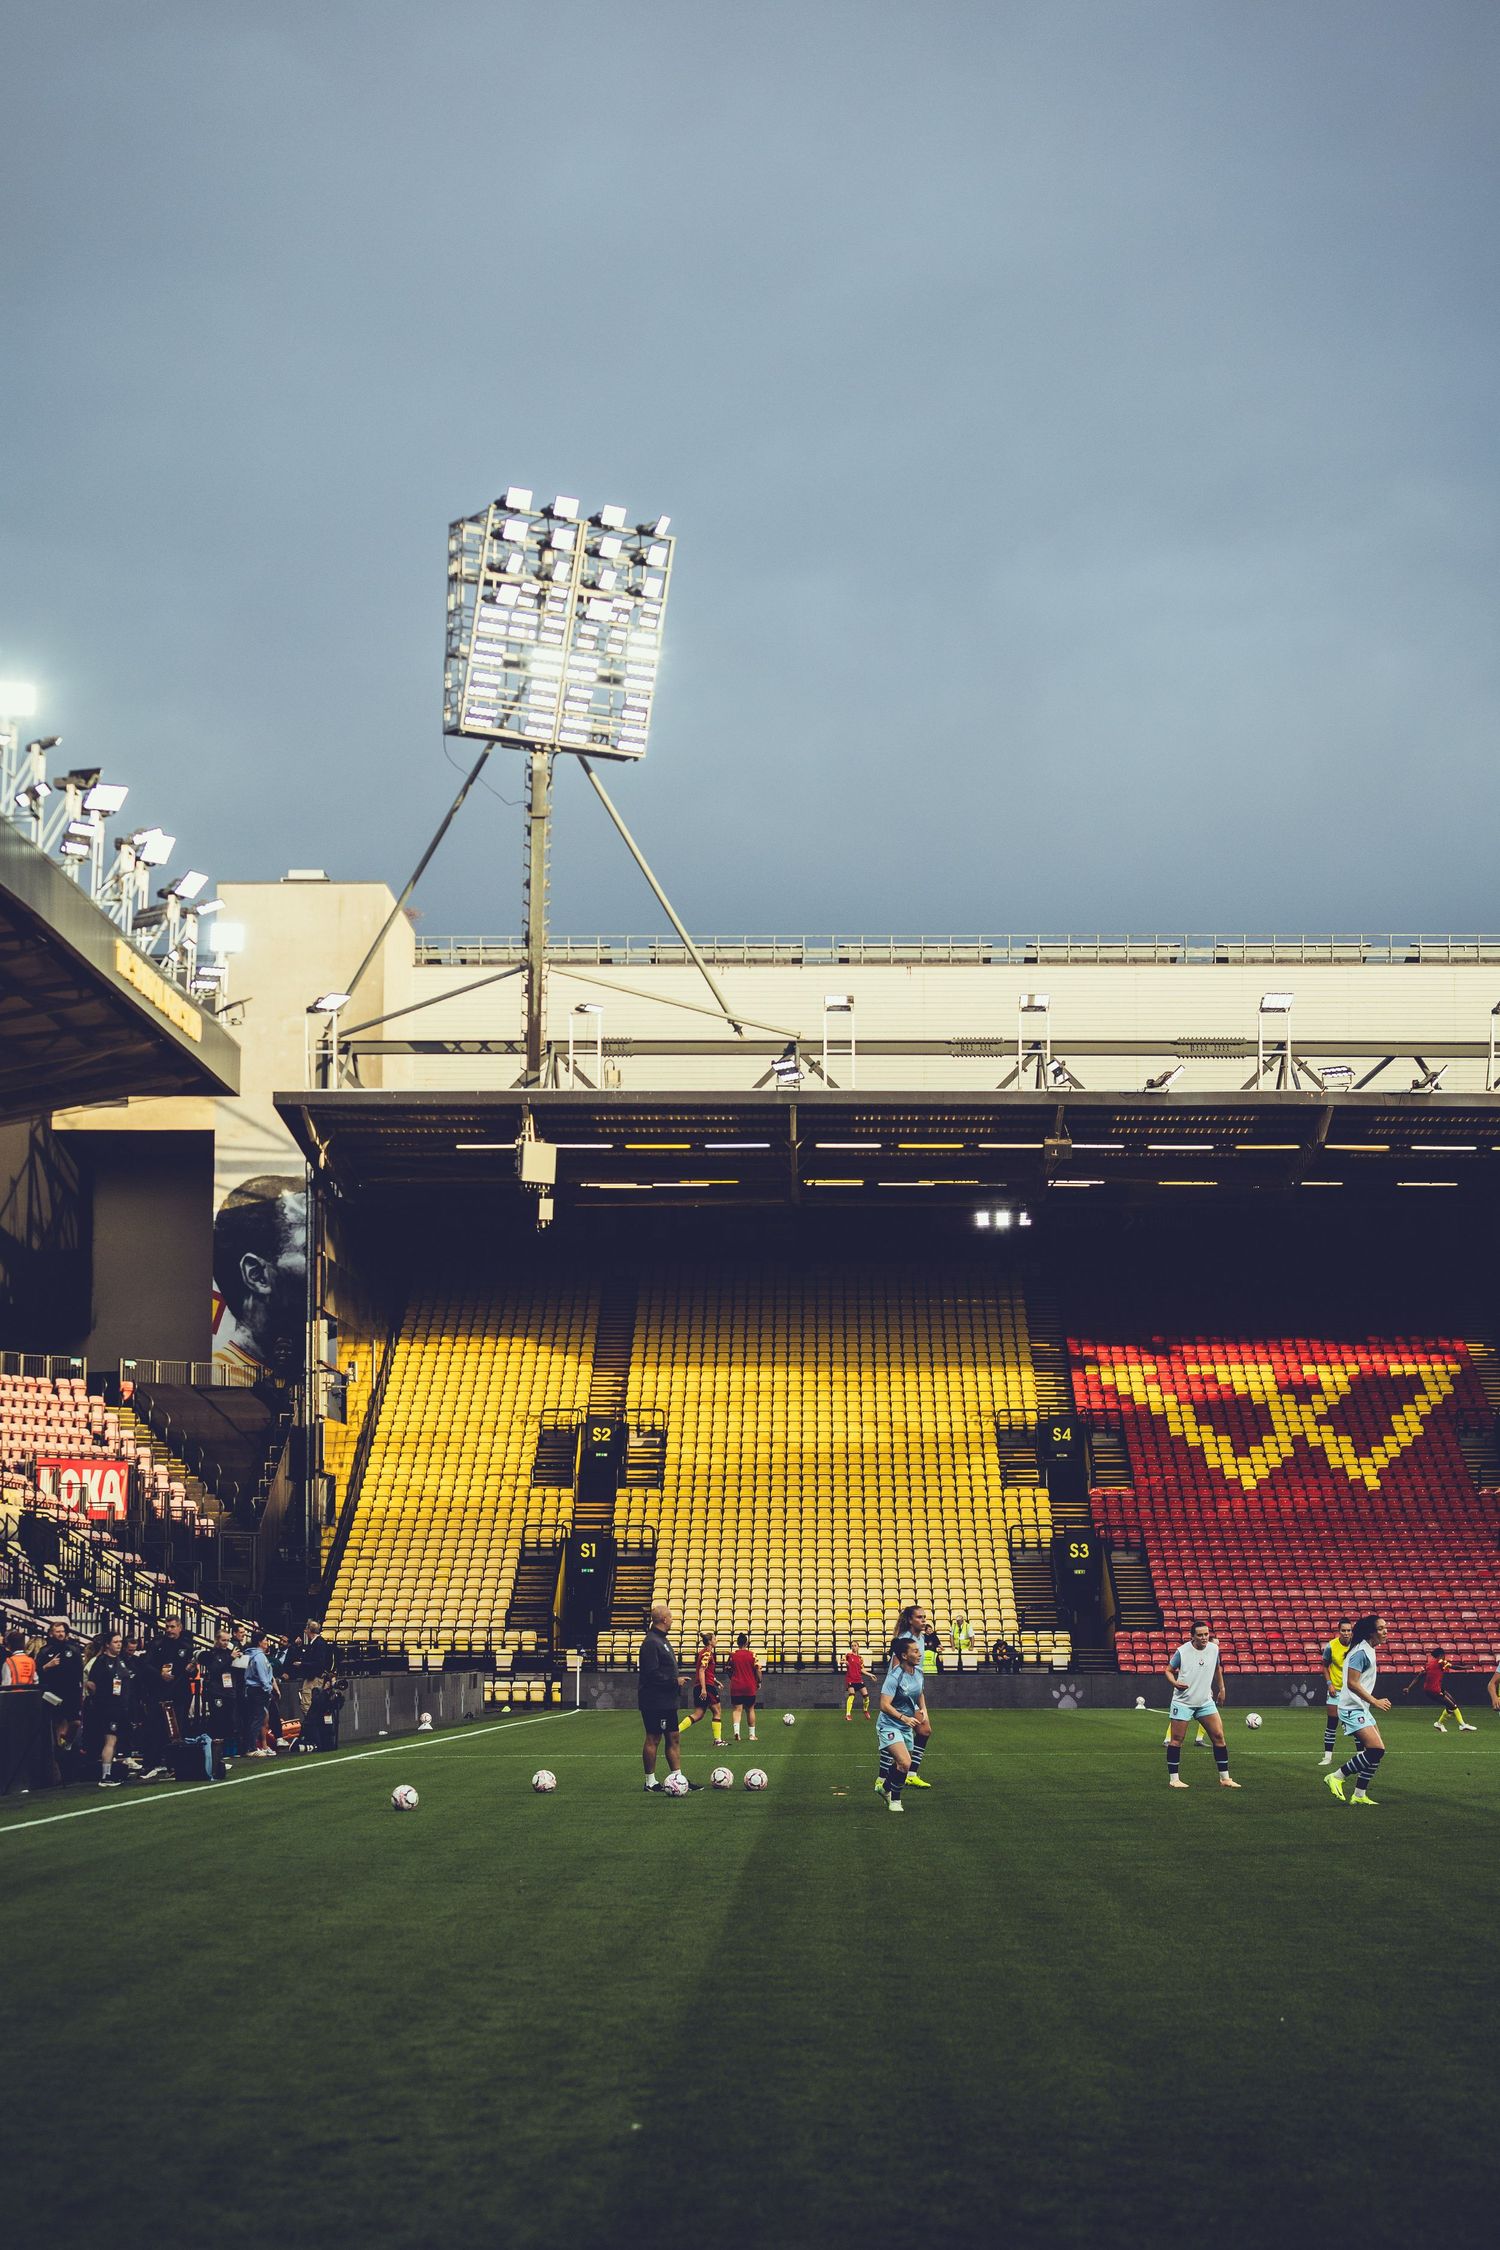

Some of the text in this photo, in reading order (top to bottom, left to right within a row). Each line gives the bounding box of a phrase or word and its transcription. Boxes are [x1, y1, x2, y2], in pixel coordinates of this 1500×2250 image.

[592, 1427, 612, 1442] S2
[1052, 1427, 1072, 1442] S4
[580, 1543, 596, 1558] S1
[1069, 1543, 1090, 1558] S3
